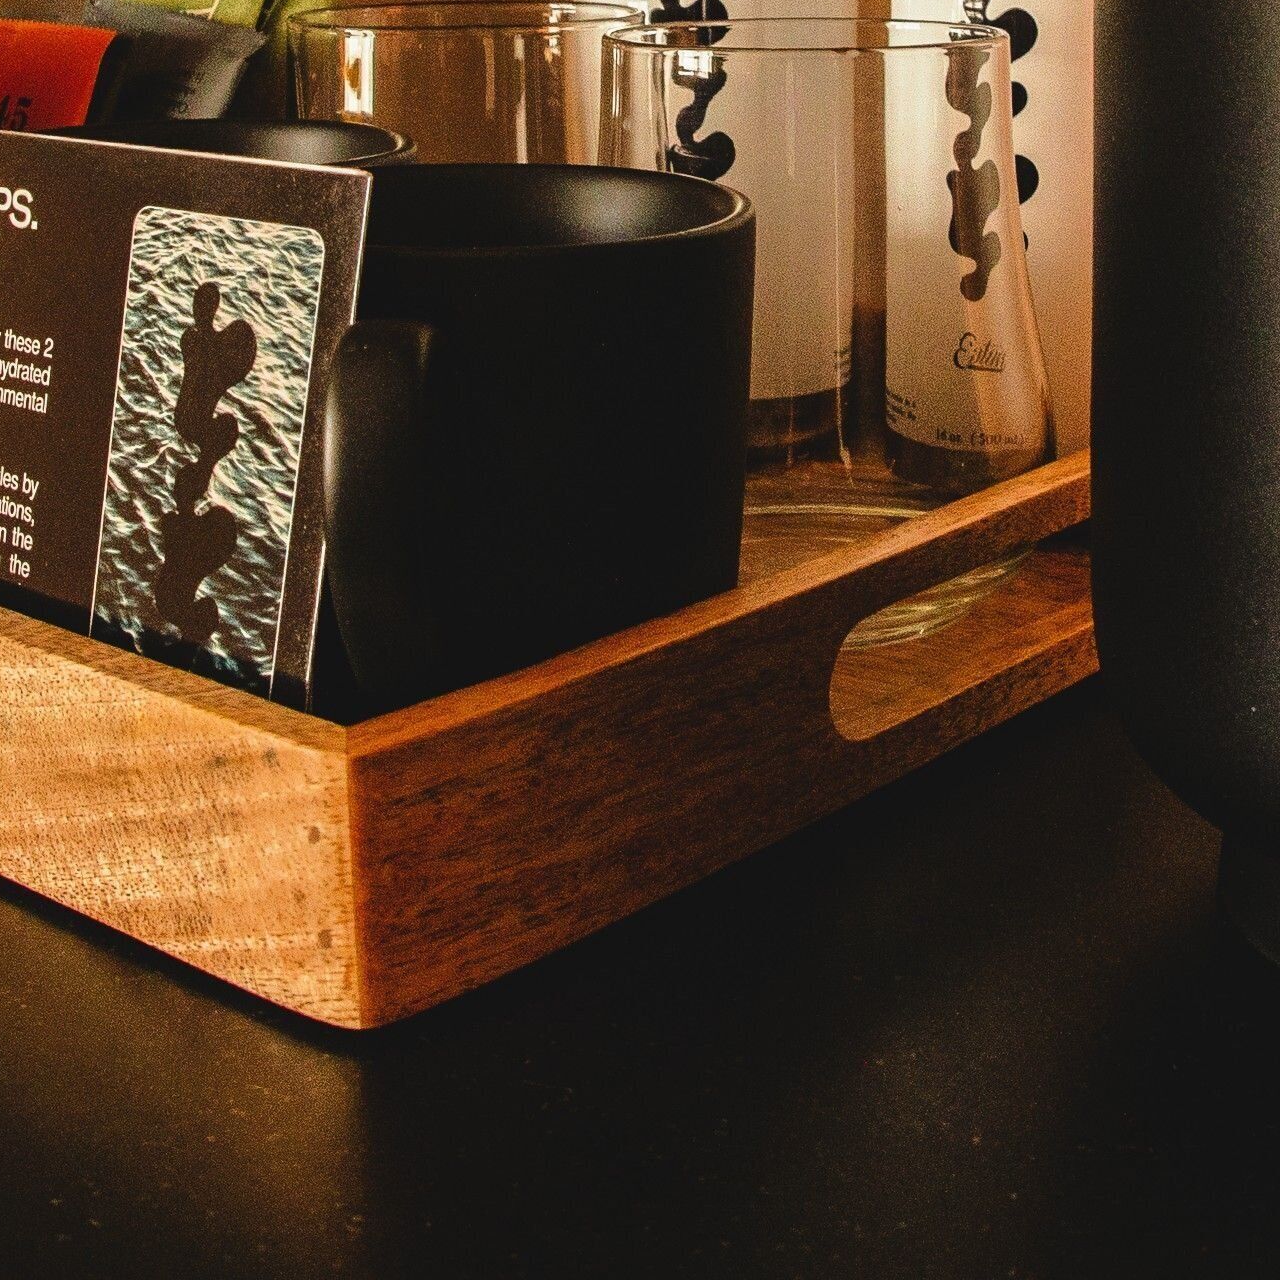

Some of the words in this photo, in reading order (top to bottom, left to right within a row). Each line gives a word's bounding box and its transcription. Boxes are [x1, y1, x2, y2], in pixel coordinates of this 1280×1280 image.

[4, 328, 41, 356] these
[42, 337, 54, 359] 2
[22, 472, 40, 501] by
[12, 525, 34, 551] the
[9, 553, 31, 578] the
